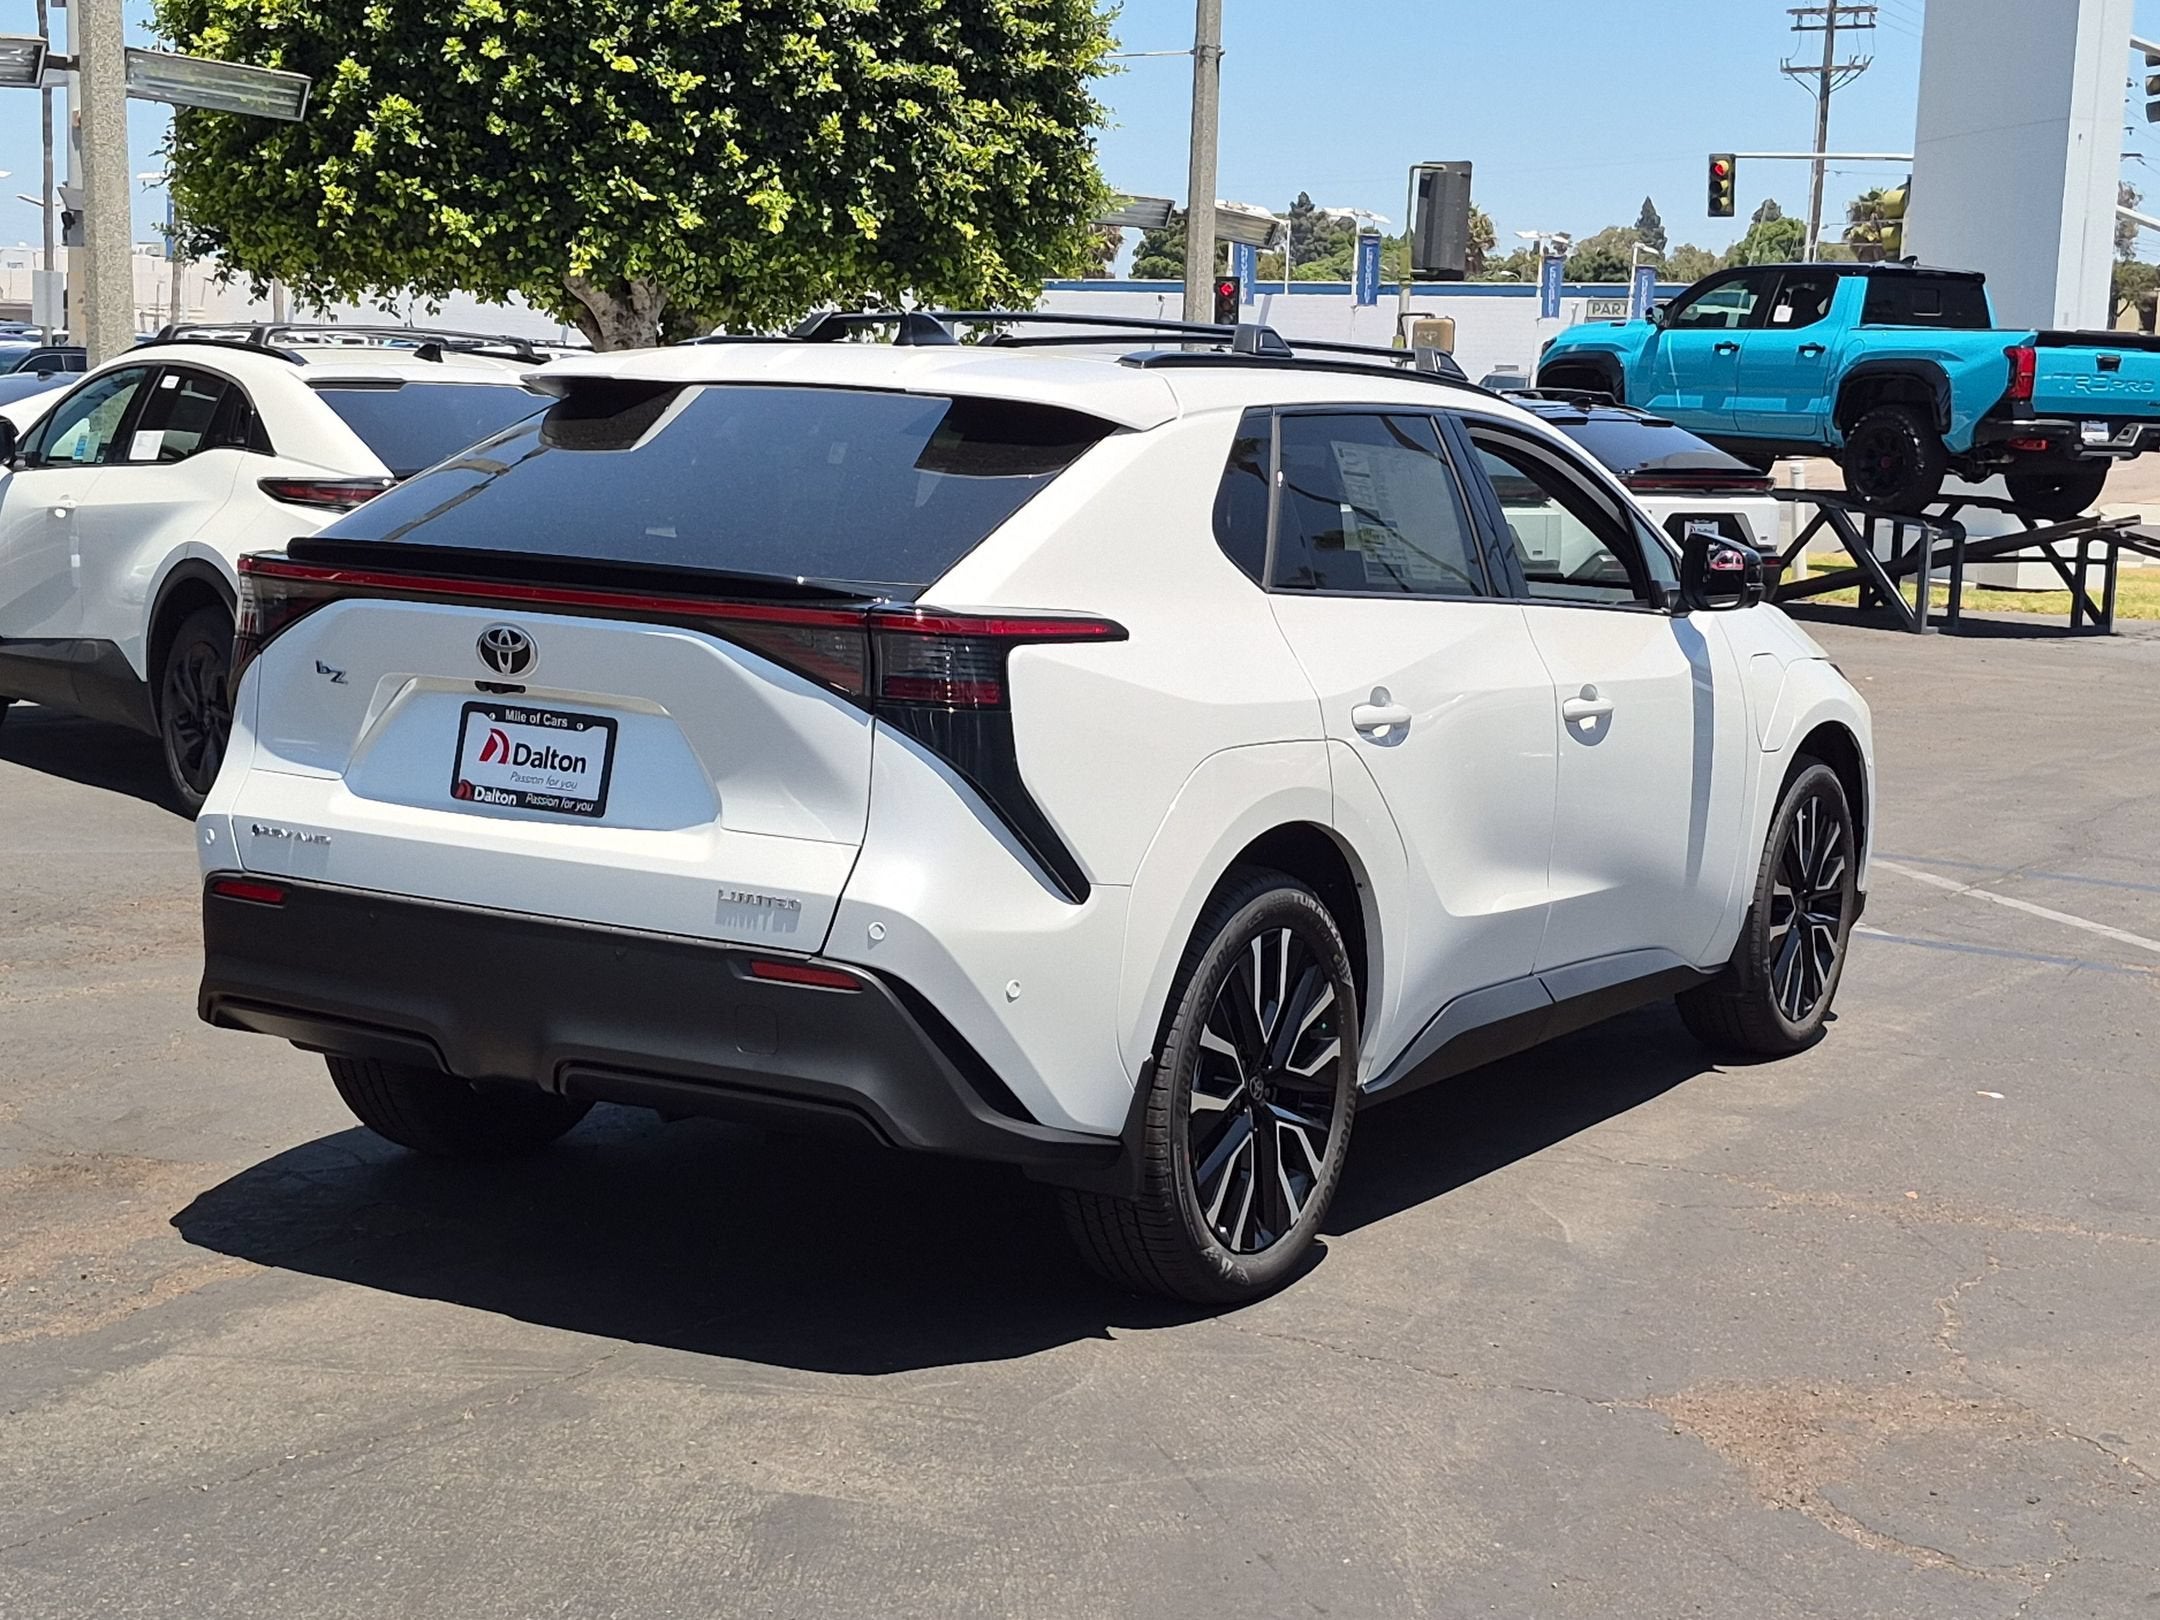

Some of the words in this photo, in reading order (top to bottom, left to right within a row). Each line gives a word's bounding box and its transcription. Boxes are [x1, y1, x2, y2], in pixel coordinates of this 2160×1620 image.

[1592, 302, 1628, 315] PART
[2050, 373, 2110, 395] TRD
[2111, 381, 2155, 393] PRO
[505, 709, 527, 722] Mile
[529, 712, 541, 724] of
[543, 713, 568, 727] Cars
[513, 742, 587, 774] Dalton
[510, 771, 544, 785] Passion
[545, 775, 559, 786] for
[560, 780, 578, 790] you
[473, 786, 517, 806] Dalton
[525, 793, 559, 807] Passion
[560, 798, 575, 809] for
[575, 802, 594, 812] you
[1292, 892, 1343, 950] TURANZA
